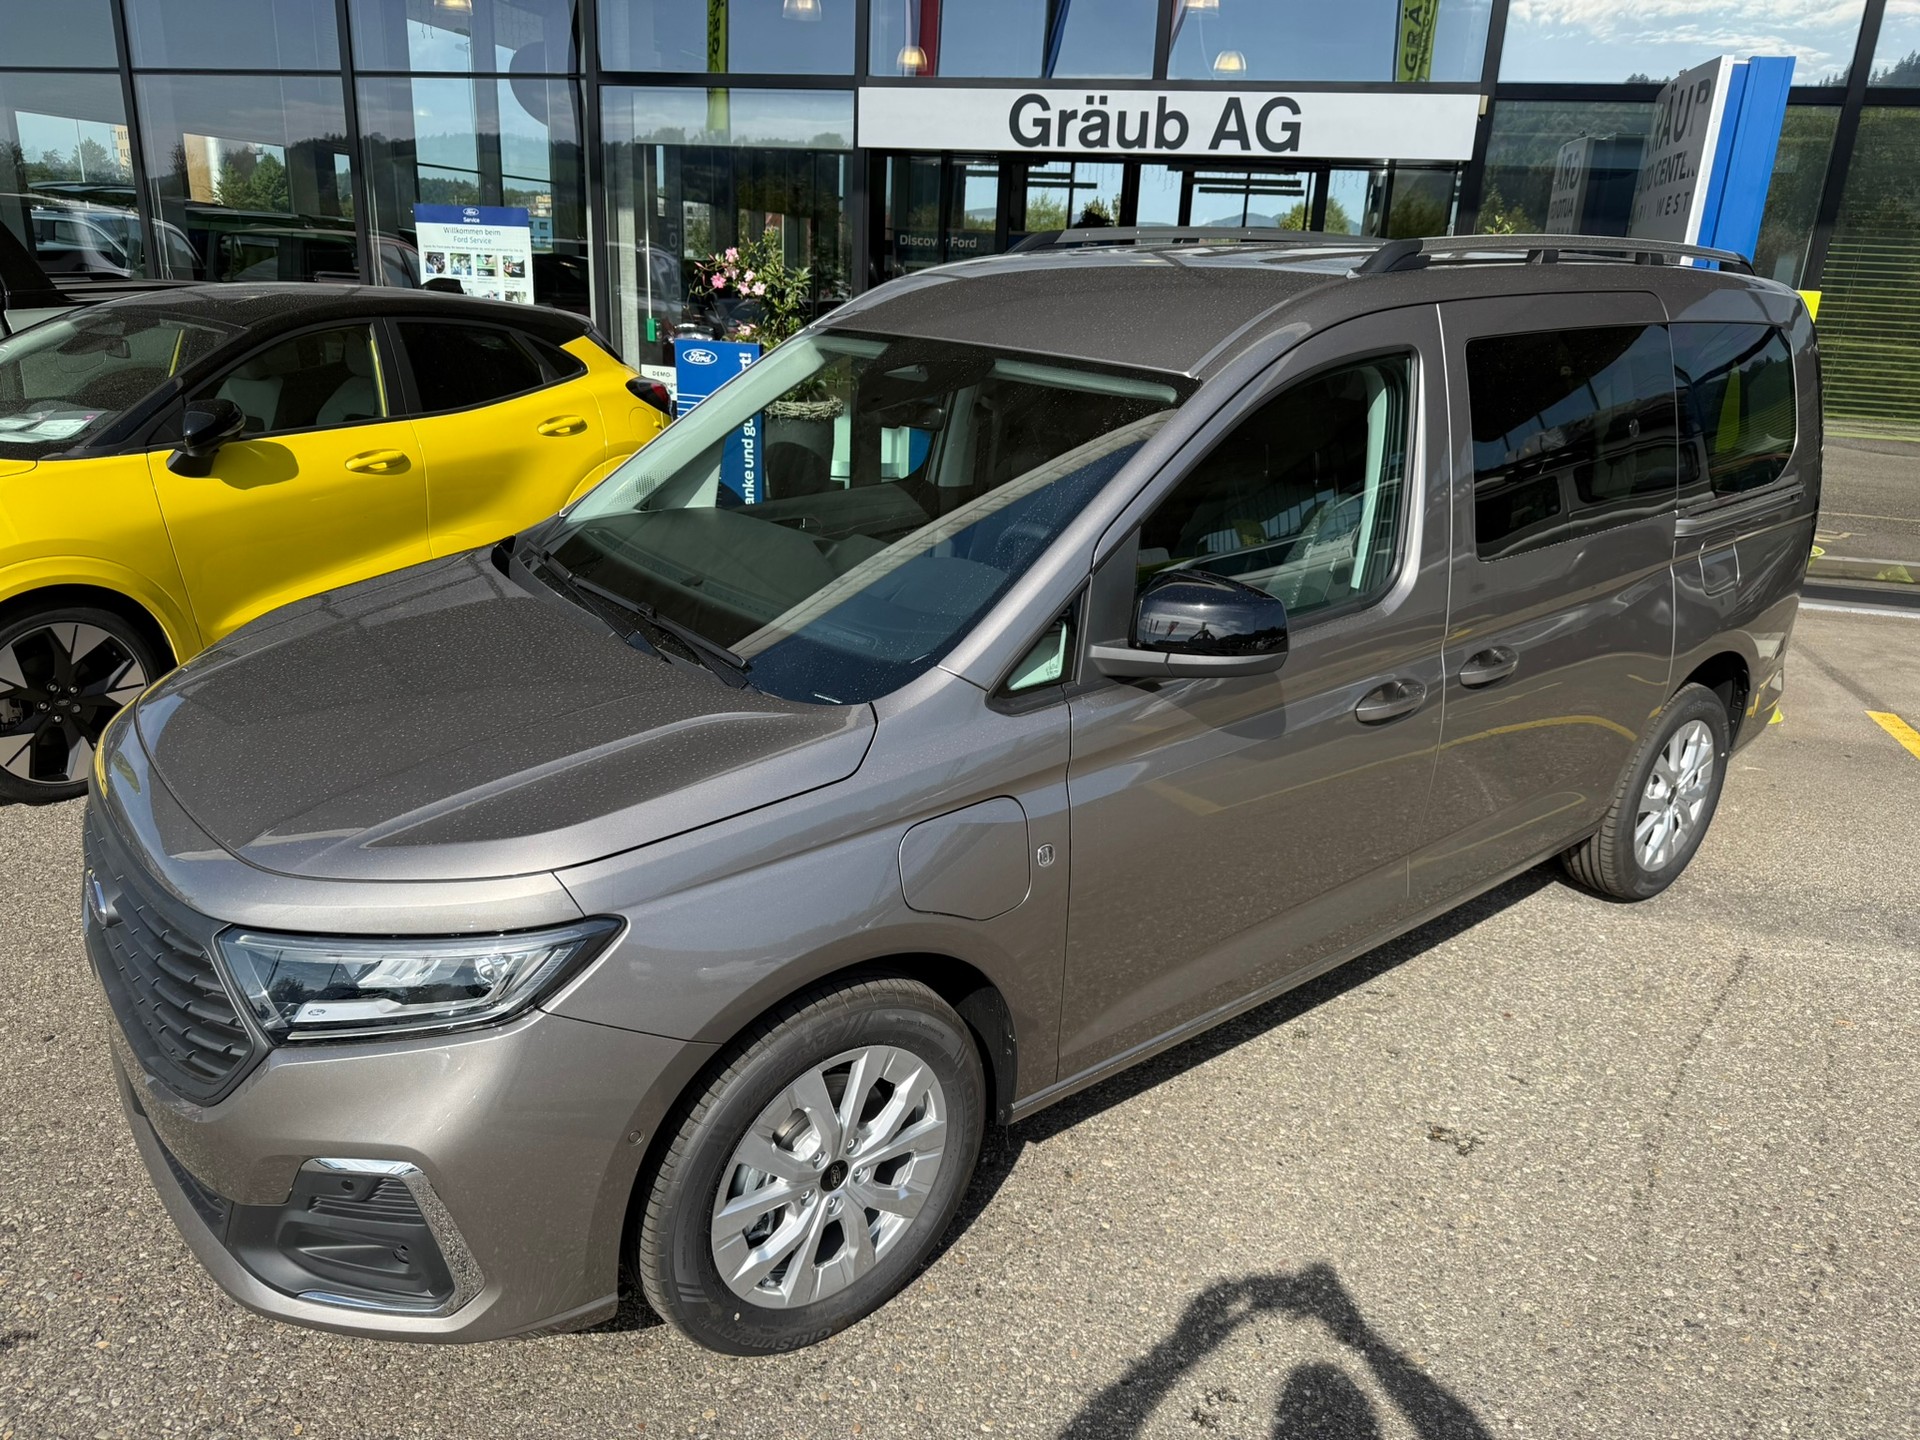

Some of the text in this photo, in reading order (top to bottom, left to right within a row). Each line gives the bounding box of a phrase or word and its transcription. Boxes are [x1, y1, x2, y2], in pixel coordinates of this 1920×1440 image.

[1008, 93, 1302, 152] Gräub AG
[1655, 191, 1691, 217] WEST
[443, 227, 501, 236] Willkommen beim
[453, 236, 469, 244] Ford
[950, 236, 977, 249] Ford
[740, 438, 755, 469] und
